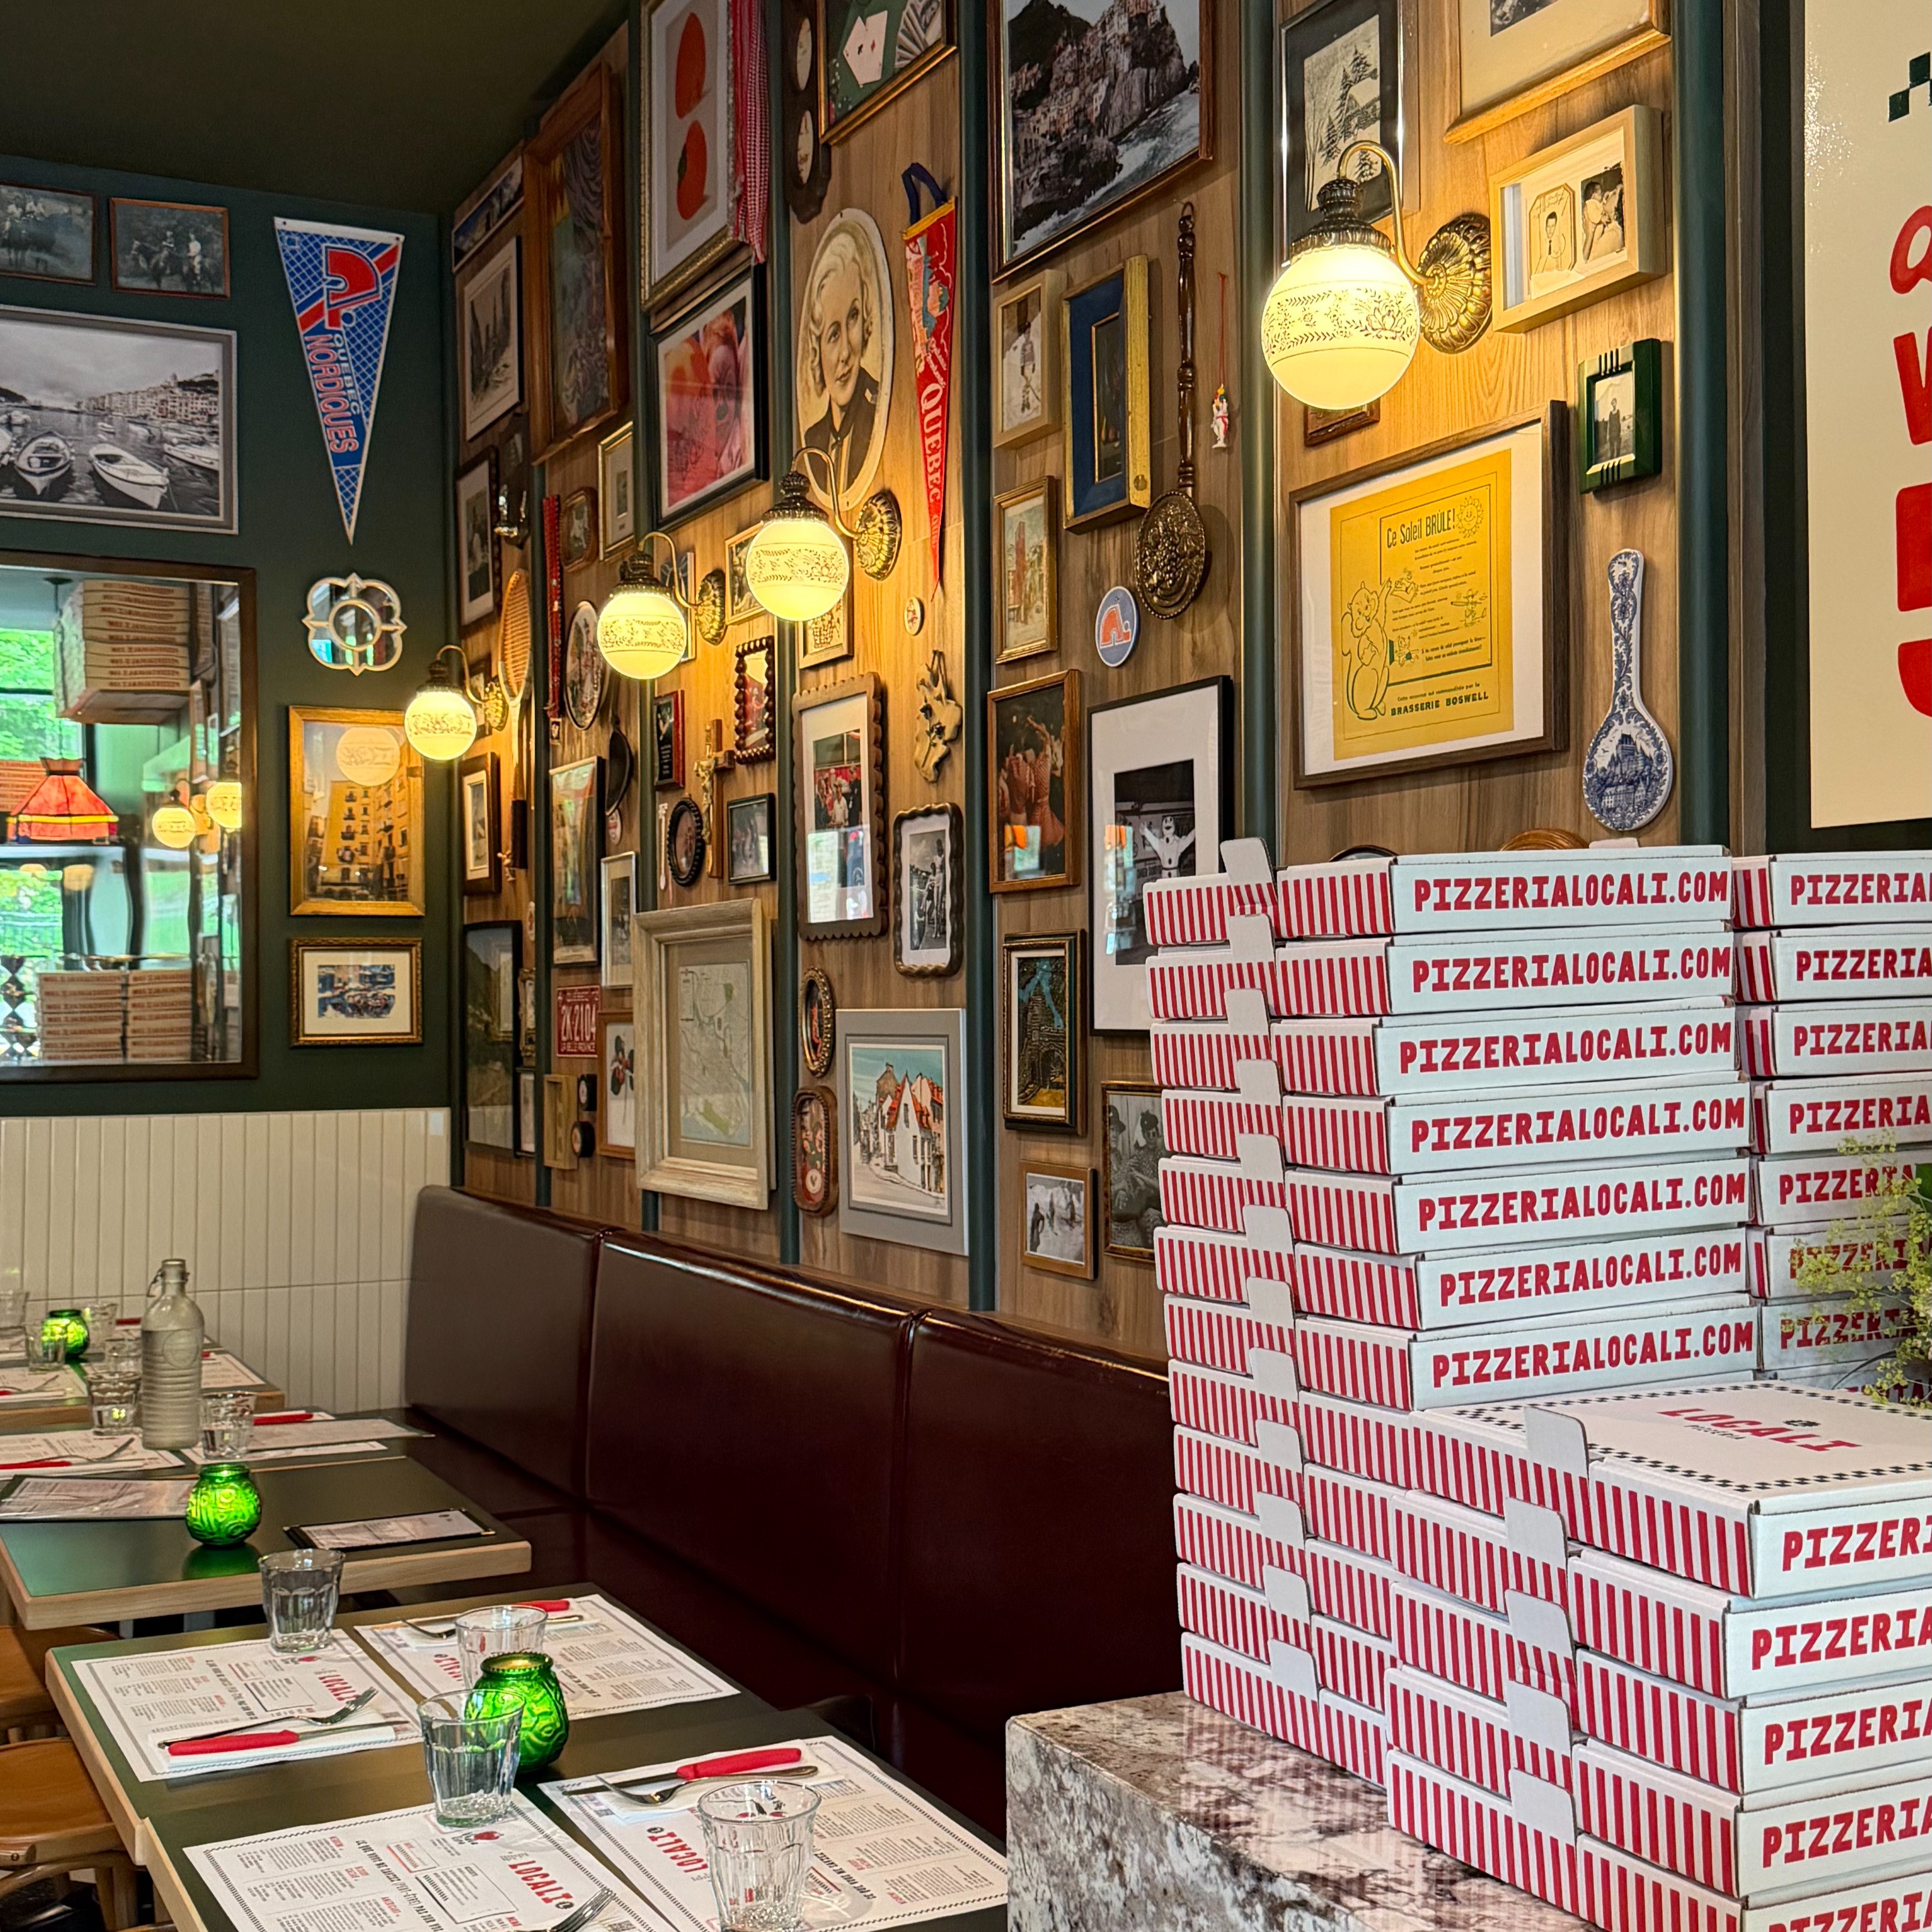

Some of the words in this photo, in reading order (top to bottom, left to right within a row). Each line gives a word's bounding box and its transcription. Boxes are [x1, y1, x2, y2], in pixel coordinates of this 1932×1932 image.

[305, 334, 359, 453] NORDIQUES
[921, 382, 943, 503] QUEBEC
[1387, 528, 1396, 548] Ce
[1400, 518, 1422, 544] Soleil
[1391, 700, 1440, 716] BRASSERIE
[1446, 692, 1489, 707] BOSWELL
[1414, 871, 1728, 912] PIZZERIALOCALI.COM
[1791, 873, 1932, 906] PIZZERIA
[1412, 947, 1730, 993] PIZZERIALOCALI.COM
[1796, 948, 1932, 981] PIZZERIA
[1400, 1022, 1731, 1074] PIZZERIALOCALI.COM
[1794, 1022, 1932, 1056] PIZZERIA
[1411, 1098, 1744, 1153] PIZZERIALOCALI.COM
[1789, 1095, 1930, 1134] PIZZERIA
[1418, 1173, 1745, 1232] PIZZERIALOCALI.COM
[1440, 1243, 1741, 1307] PIZZERIALOCALI.COM
[1432, 1321, 1753, 1388] PIZZERIALOCALI.COM
[1657, 1408, 1862, 1452] LOCALI
[318, 1675, 360, 1701] LOCALI
[648, 1832, 708, 1873] LOCALI
[508, 1860, 573, 1904] LOCALI
